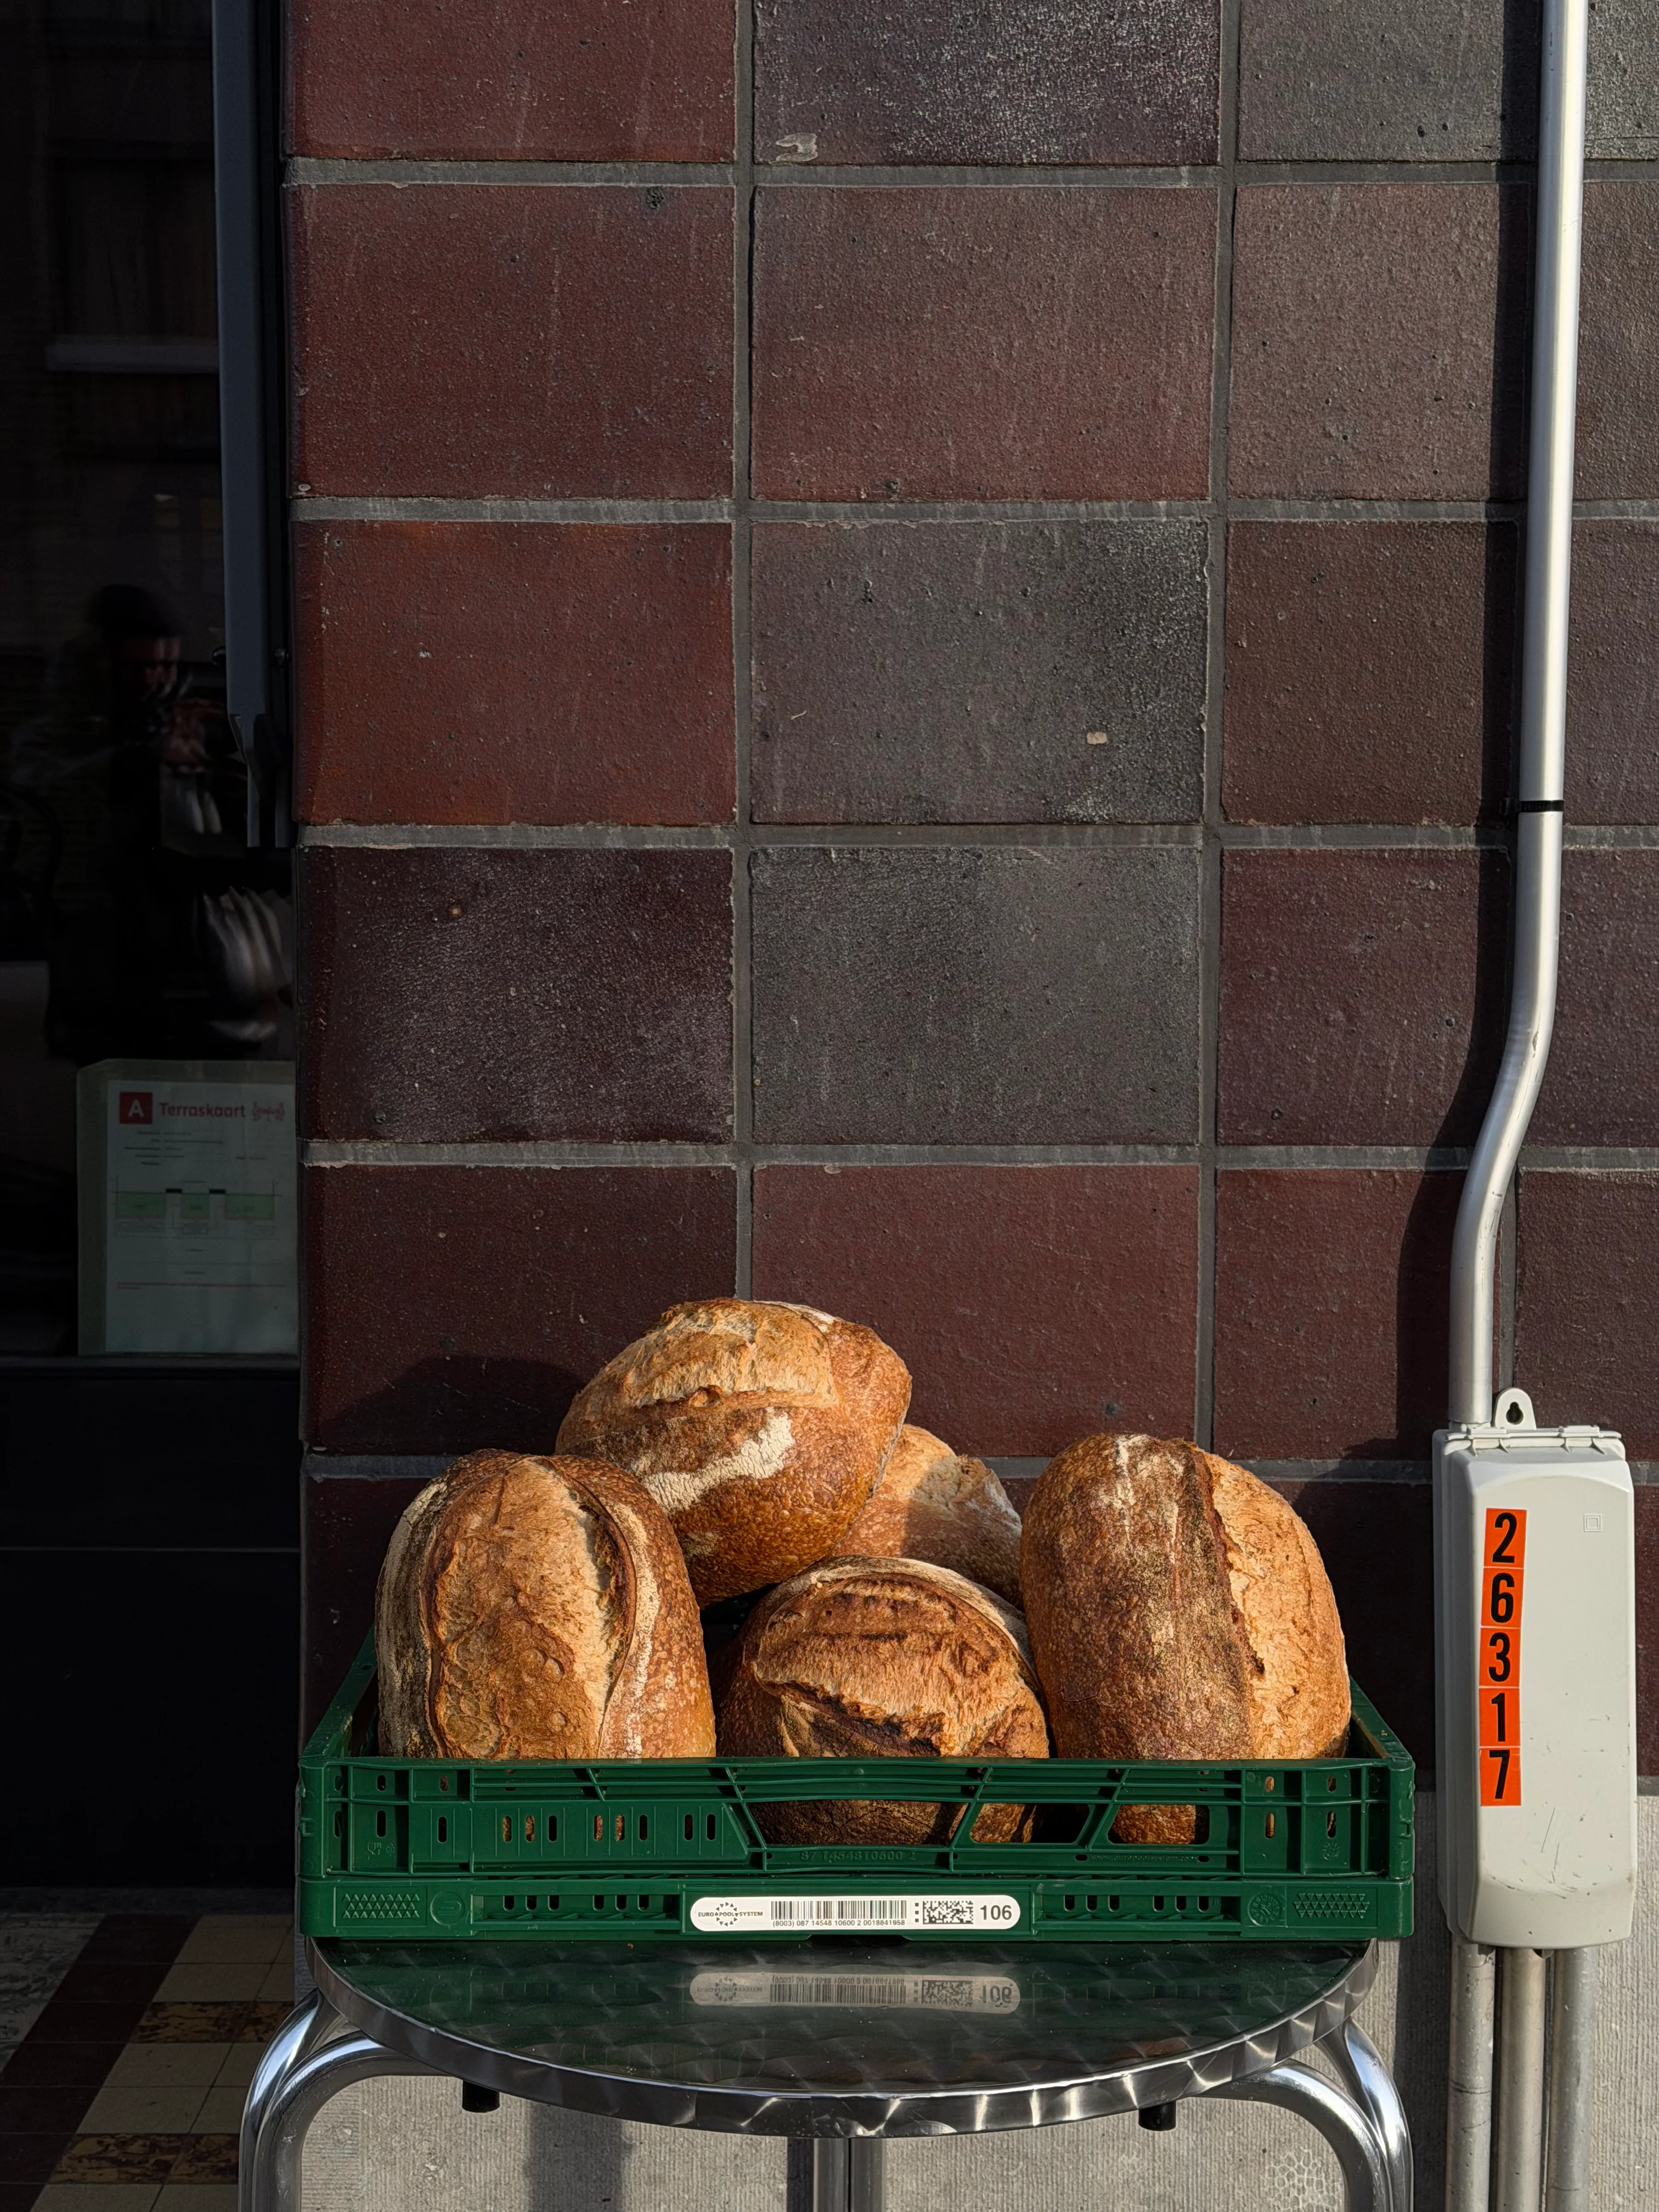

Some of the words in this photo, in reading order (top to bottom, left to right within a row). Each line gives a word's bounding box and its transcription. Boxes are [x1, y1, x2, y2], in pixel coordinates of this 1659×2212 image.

[128, 1098, 145, 1118] A
[160, 1102, 246, 1118] Terraskaart
[1488, 1512, 1517, 1799] 26317
[908, 1851, 916, 1860] 2
[980, 1905, 1012, 1921] 106
[772, 1920, 795, 1928] (8003)
